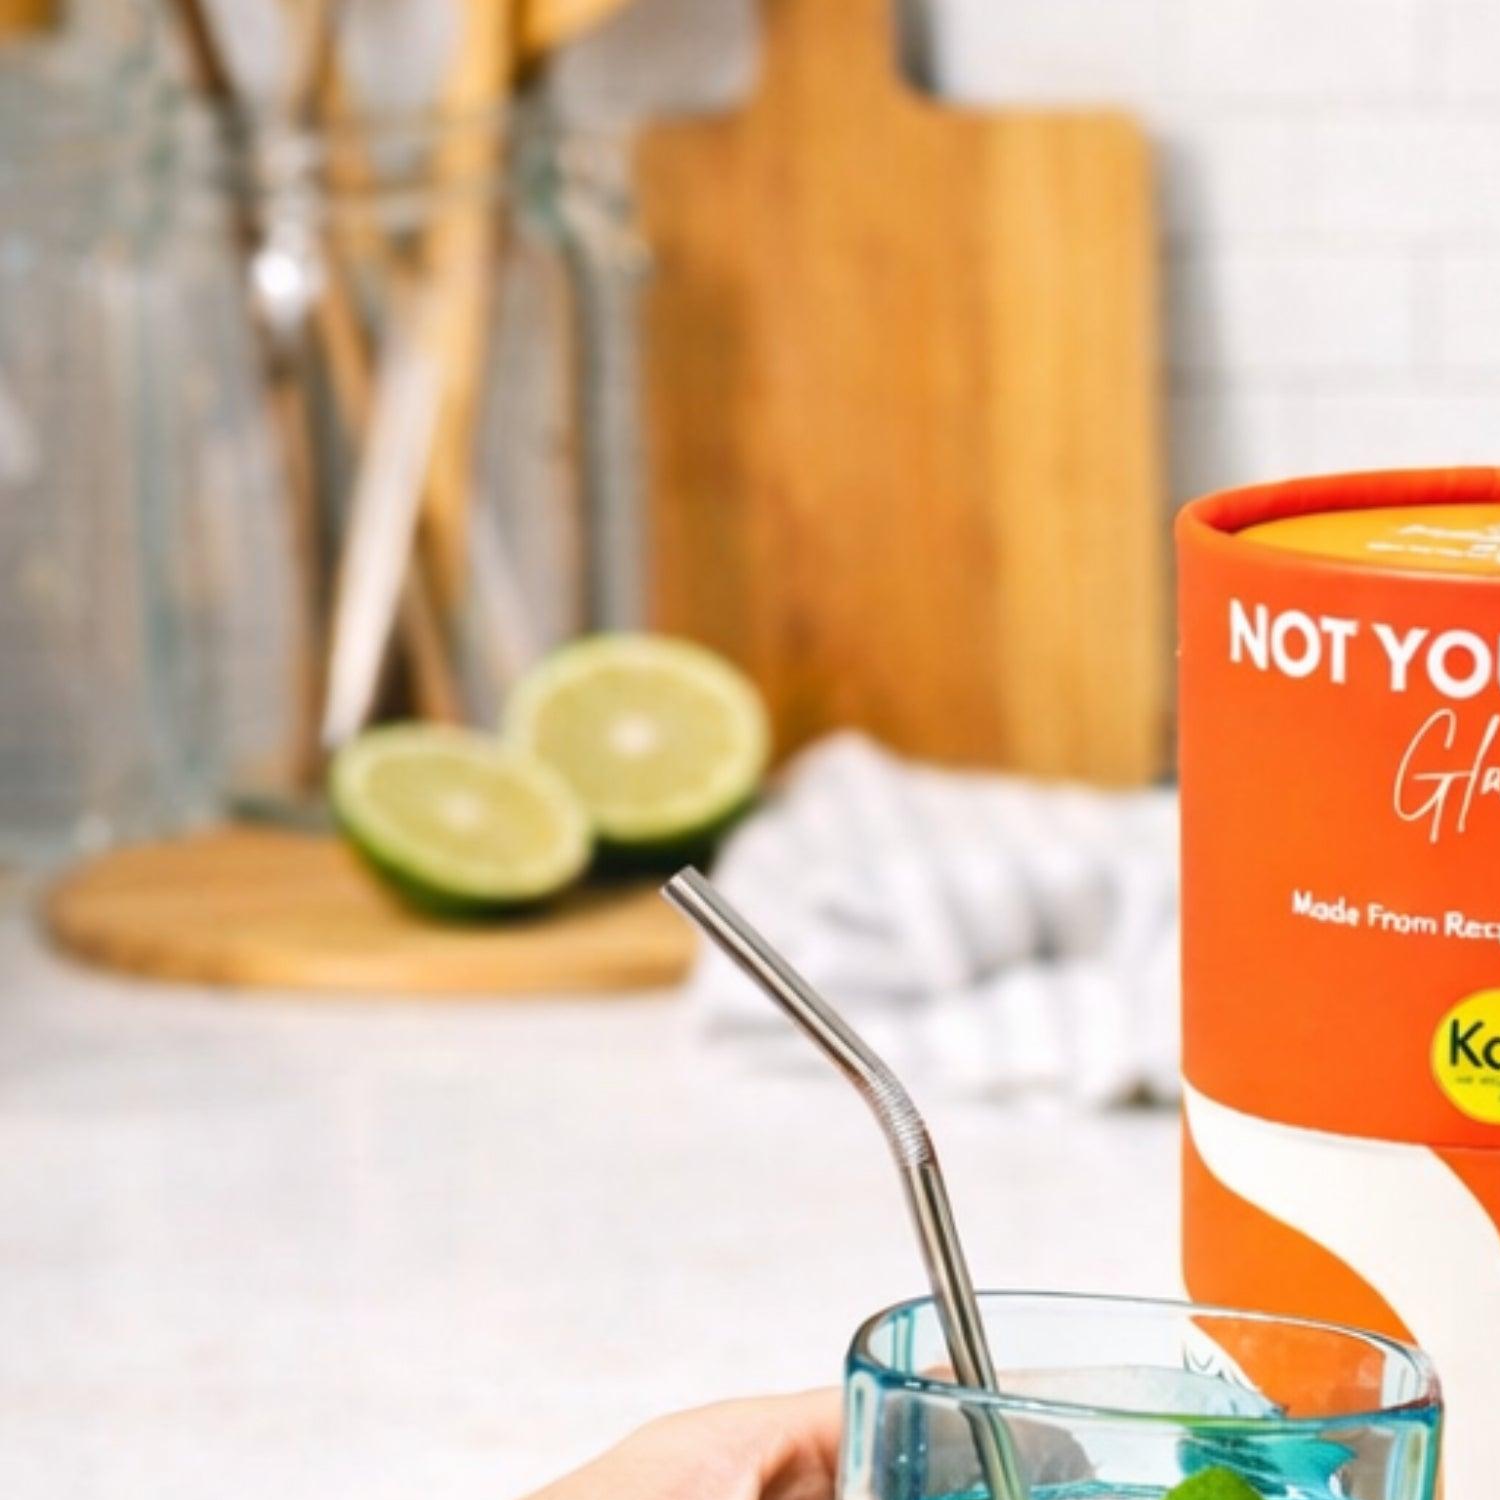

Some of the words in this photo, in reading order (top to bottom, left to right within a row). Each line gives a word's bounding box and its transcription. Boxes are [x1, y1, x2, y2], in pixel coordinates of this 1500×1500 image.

[1229, 597, 1358, 685] NOT
[1292, 887, 1360, 927] Made
[1367, 901, 1439, 936] From
